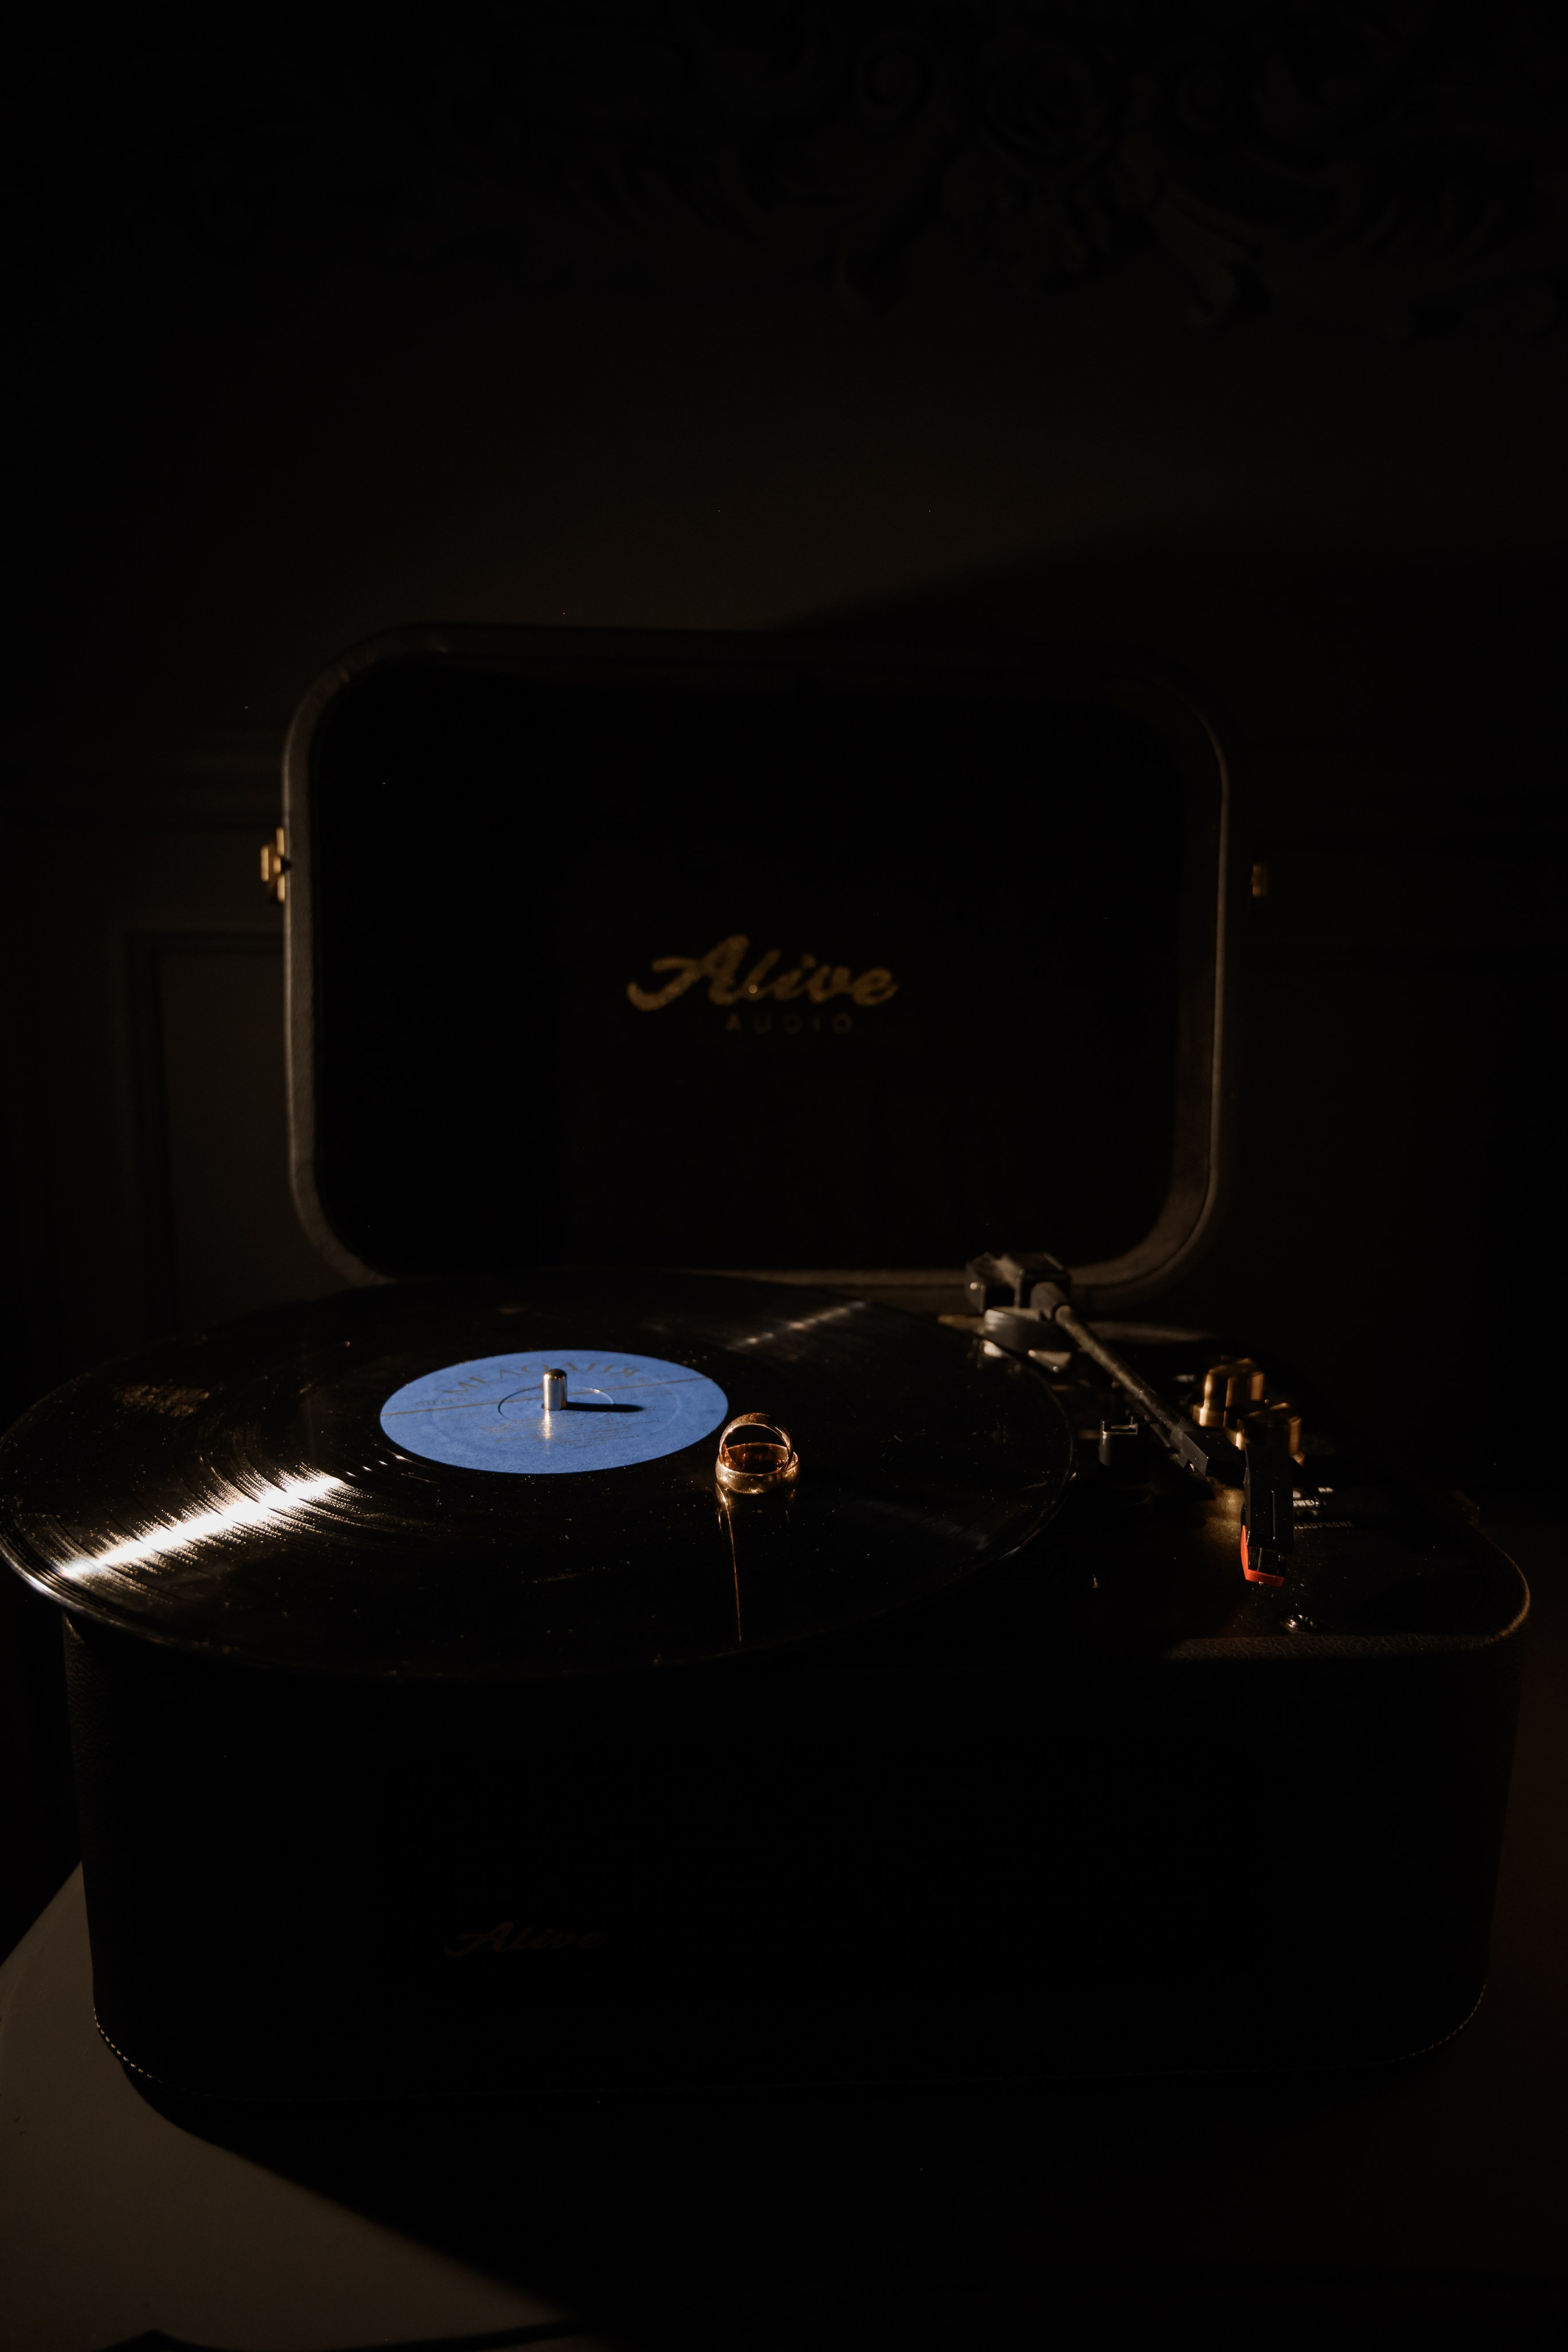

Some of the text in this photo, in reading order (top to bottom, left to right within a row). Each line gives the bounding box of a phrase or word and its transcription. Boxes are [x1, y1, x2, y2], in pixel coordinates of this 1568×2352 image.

[625, 933, 900, 1012] Alive
[725, 1012, 853, 1034] AUDIO
[443, 1920, 608, 1958] Alive
